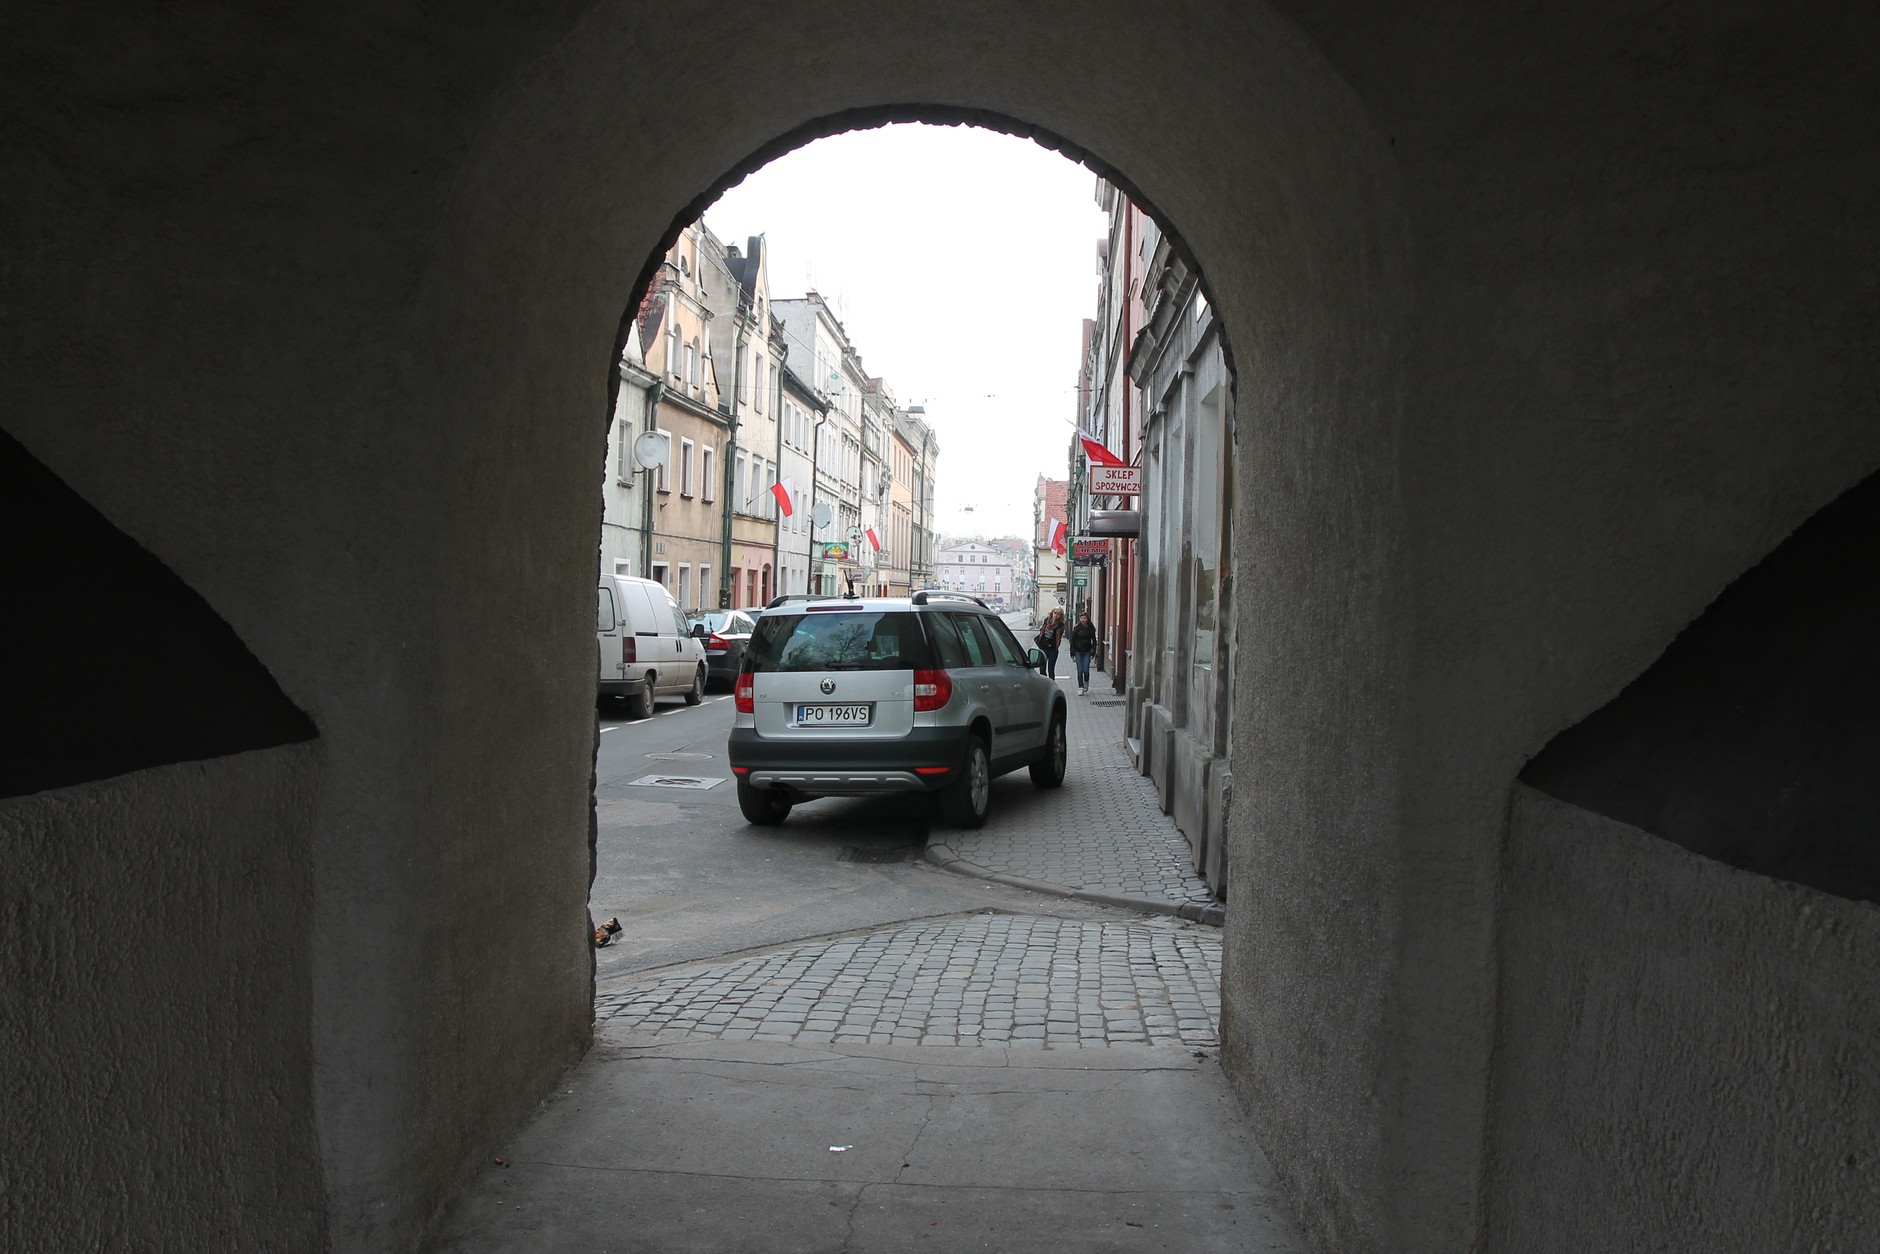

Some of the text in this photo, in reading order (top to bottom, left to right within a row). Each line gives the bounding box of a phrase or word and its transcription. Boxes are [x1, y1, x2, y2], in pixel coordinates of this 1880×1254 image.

[1105, 470, 1134, 480] SKLEP
[1076, 539, 1106, 547] AUTO
[805, 707, 867, 720] PO 196VS
